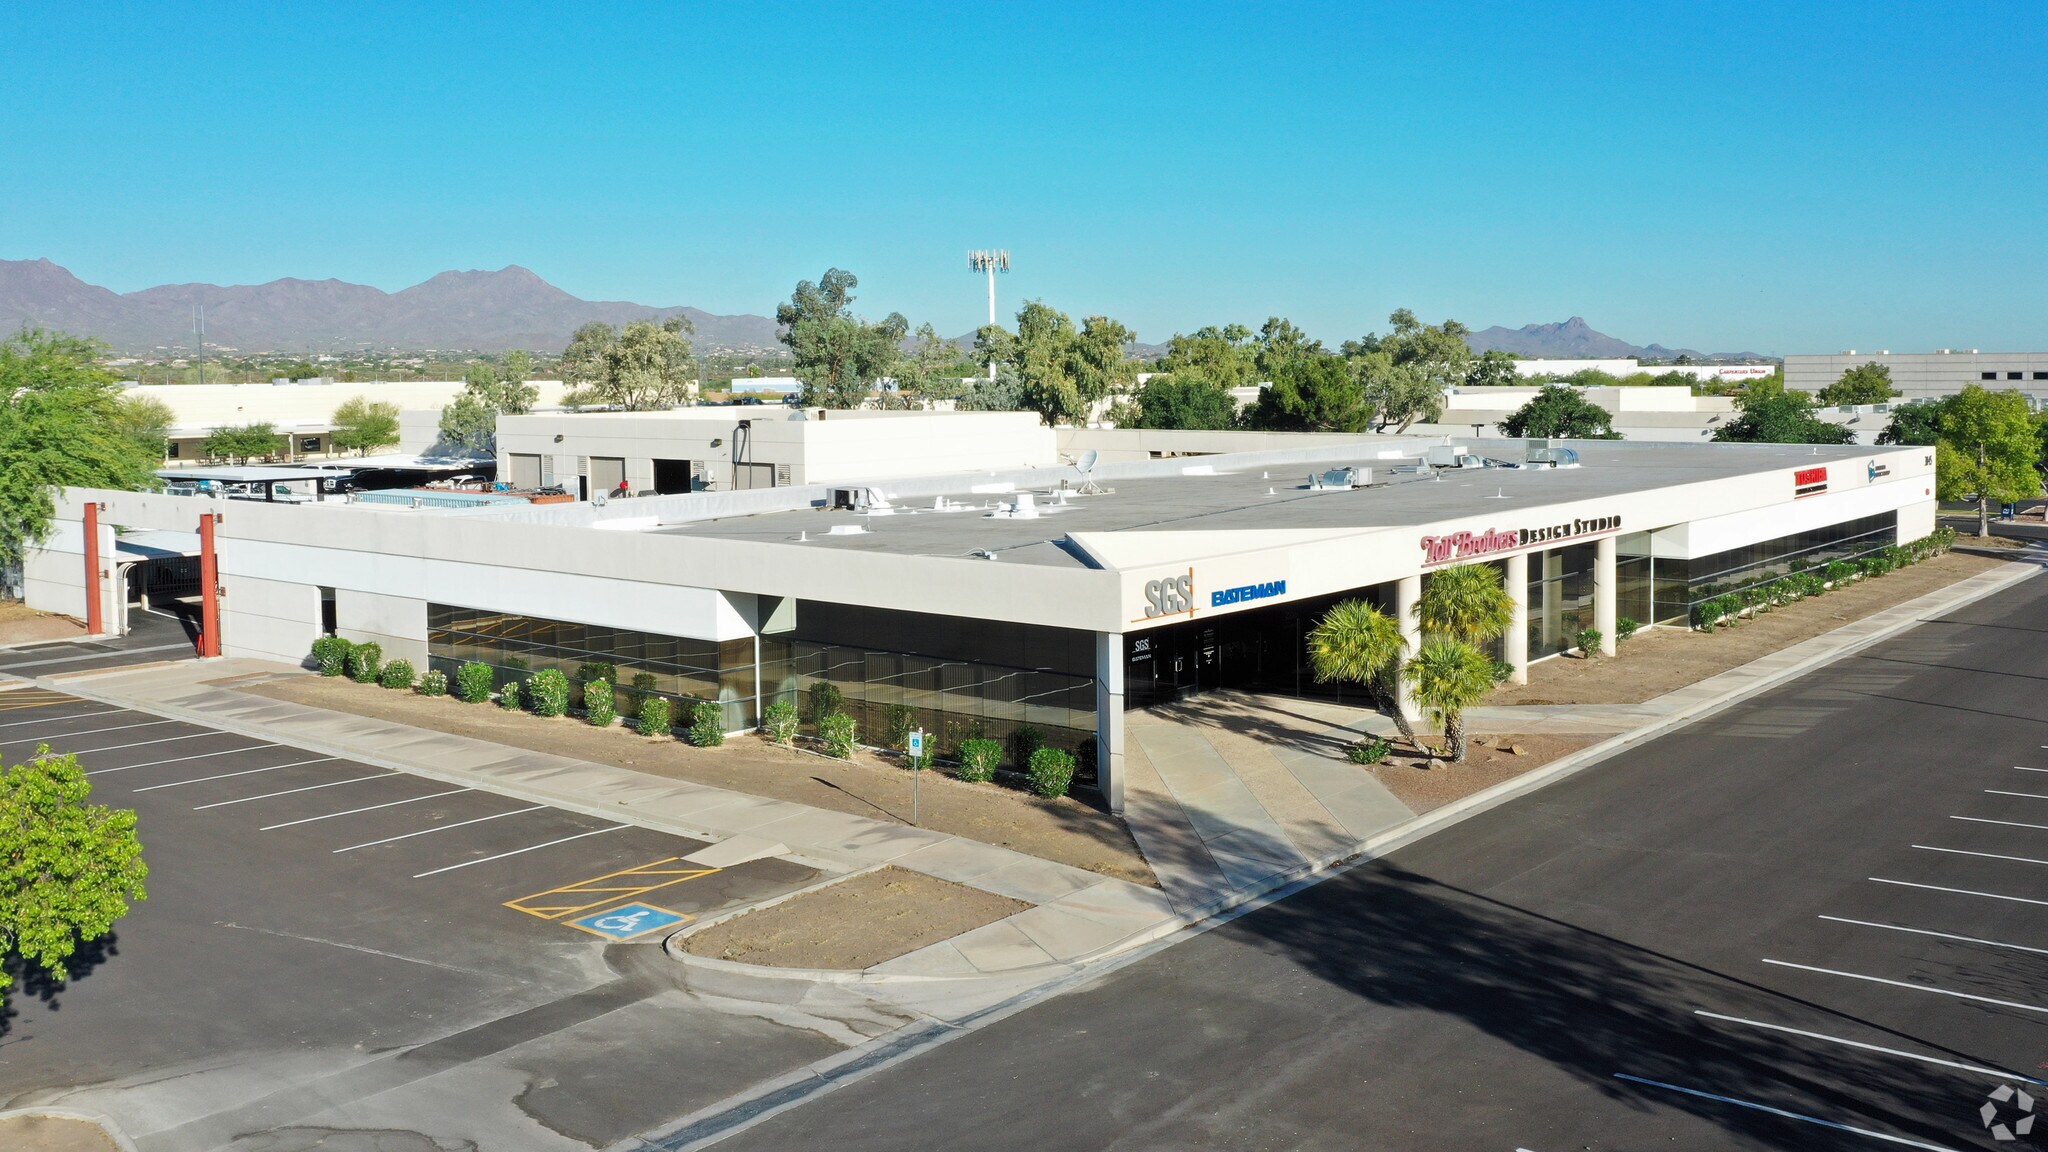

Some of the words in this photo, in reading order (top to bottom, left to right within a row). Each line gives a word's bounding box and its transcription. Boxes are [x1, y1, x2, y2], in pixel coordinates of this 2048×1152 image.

[1794, 467, 1827, 486] TOSHIBA
[1420, 535, 1452, 563] Toll
[1451, 528, 1518, 557] Brothers
[1518, 524, 1572, 545] DESIGN
[1573, 515, 1622, 535] STUDIO
[1145, 574, 1193, 618] SGS
[1211, 580, 1286, 607] BATEMAN
[1135, 639, 1149, 652] SGS
